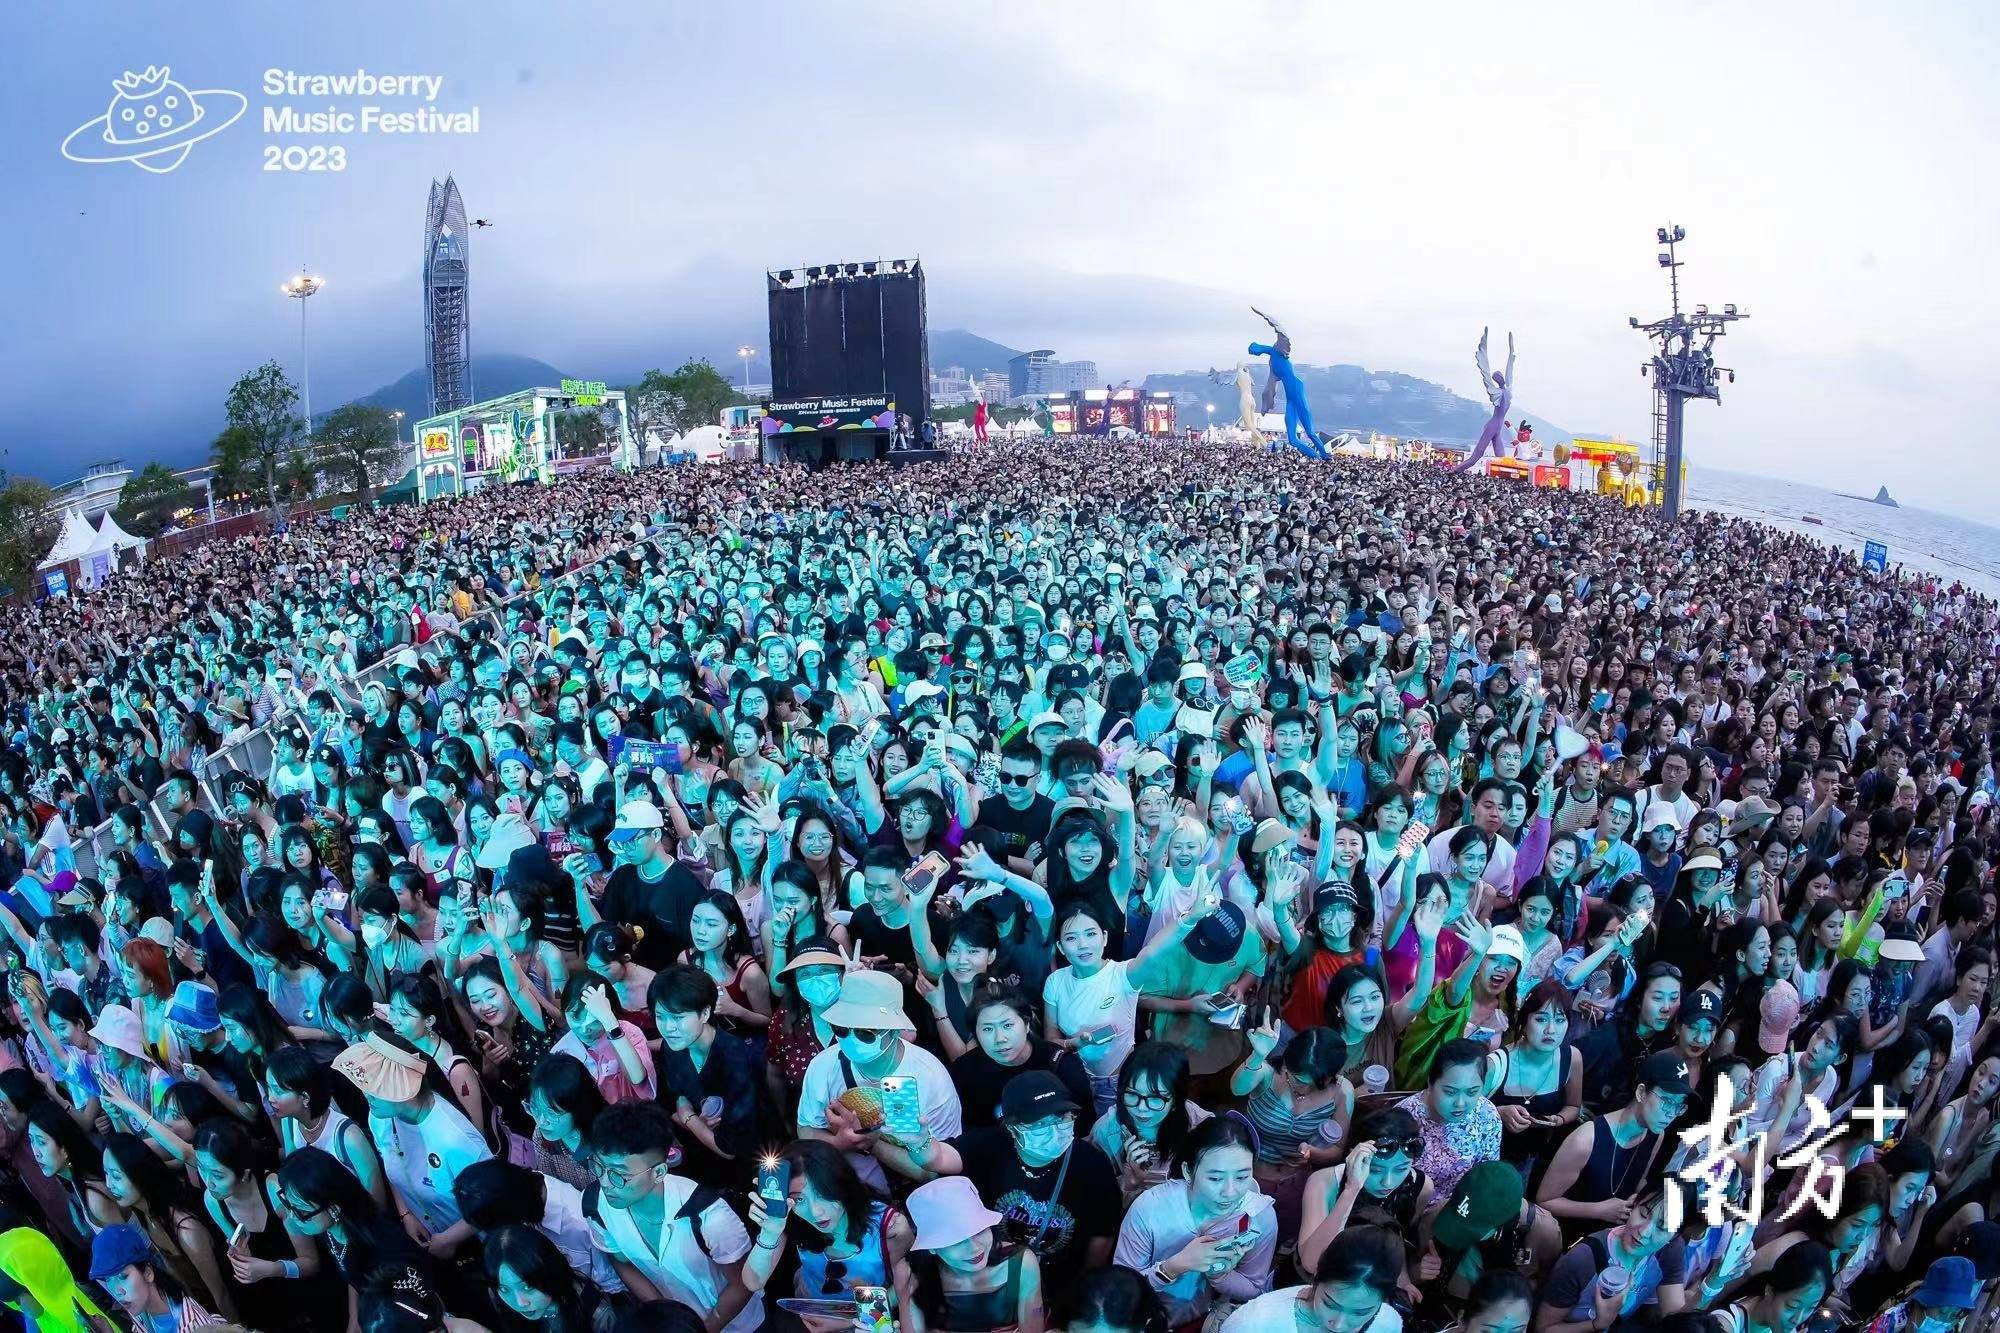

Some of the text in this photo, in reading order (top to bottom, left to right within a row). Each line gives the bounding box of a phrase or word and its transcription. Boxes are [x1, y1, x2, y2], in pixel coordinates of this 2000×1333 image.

[769, 398, 885, 411] Strawberry Music Festival
[1700, 993, 1713, 1010] LA
[1457, 1195, 1470, 1218] LA
